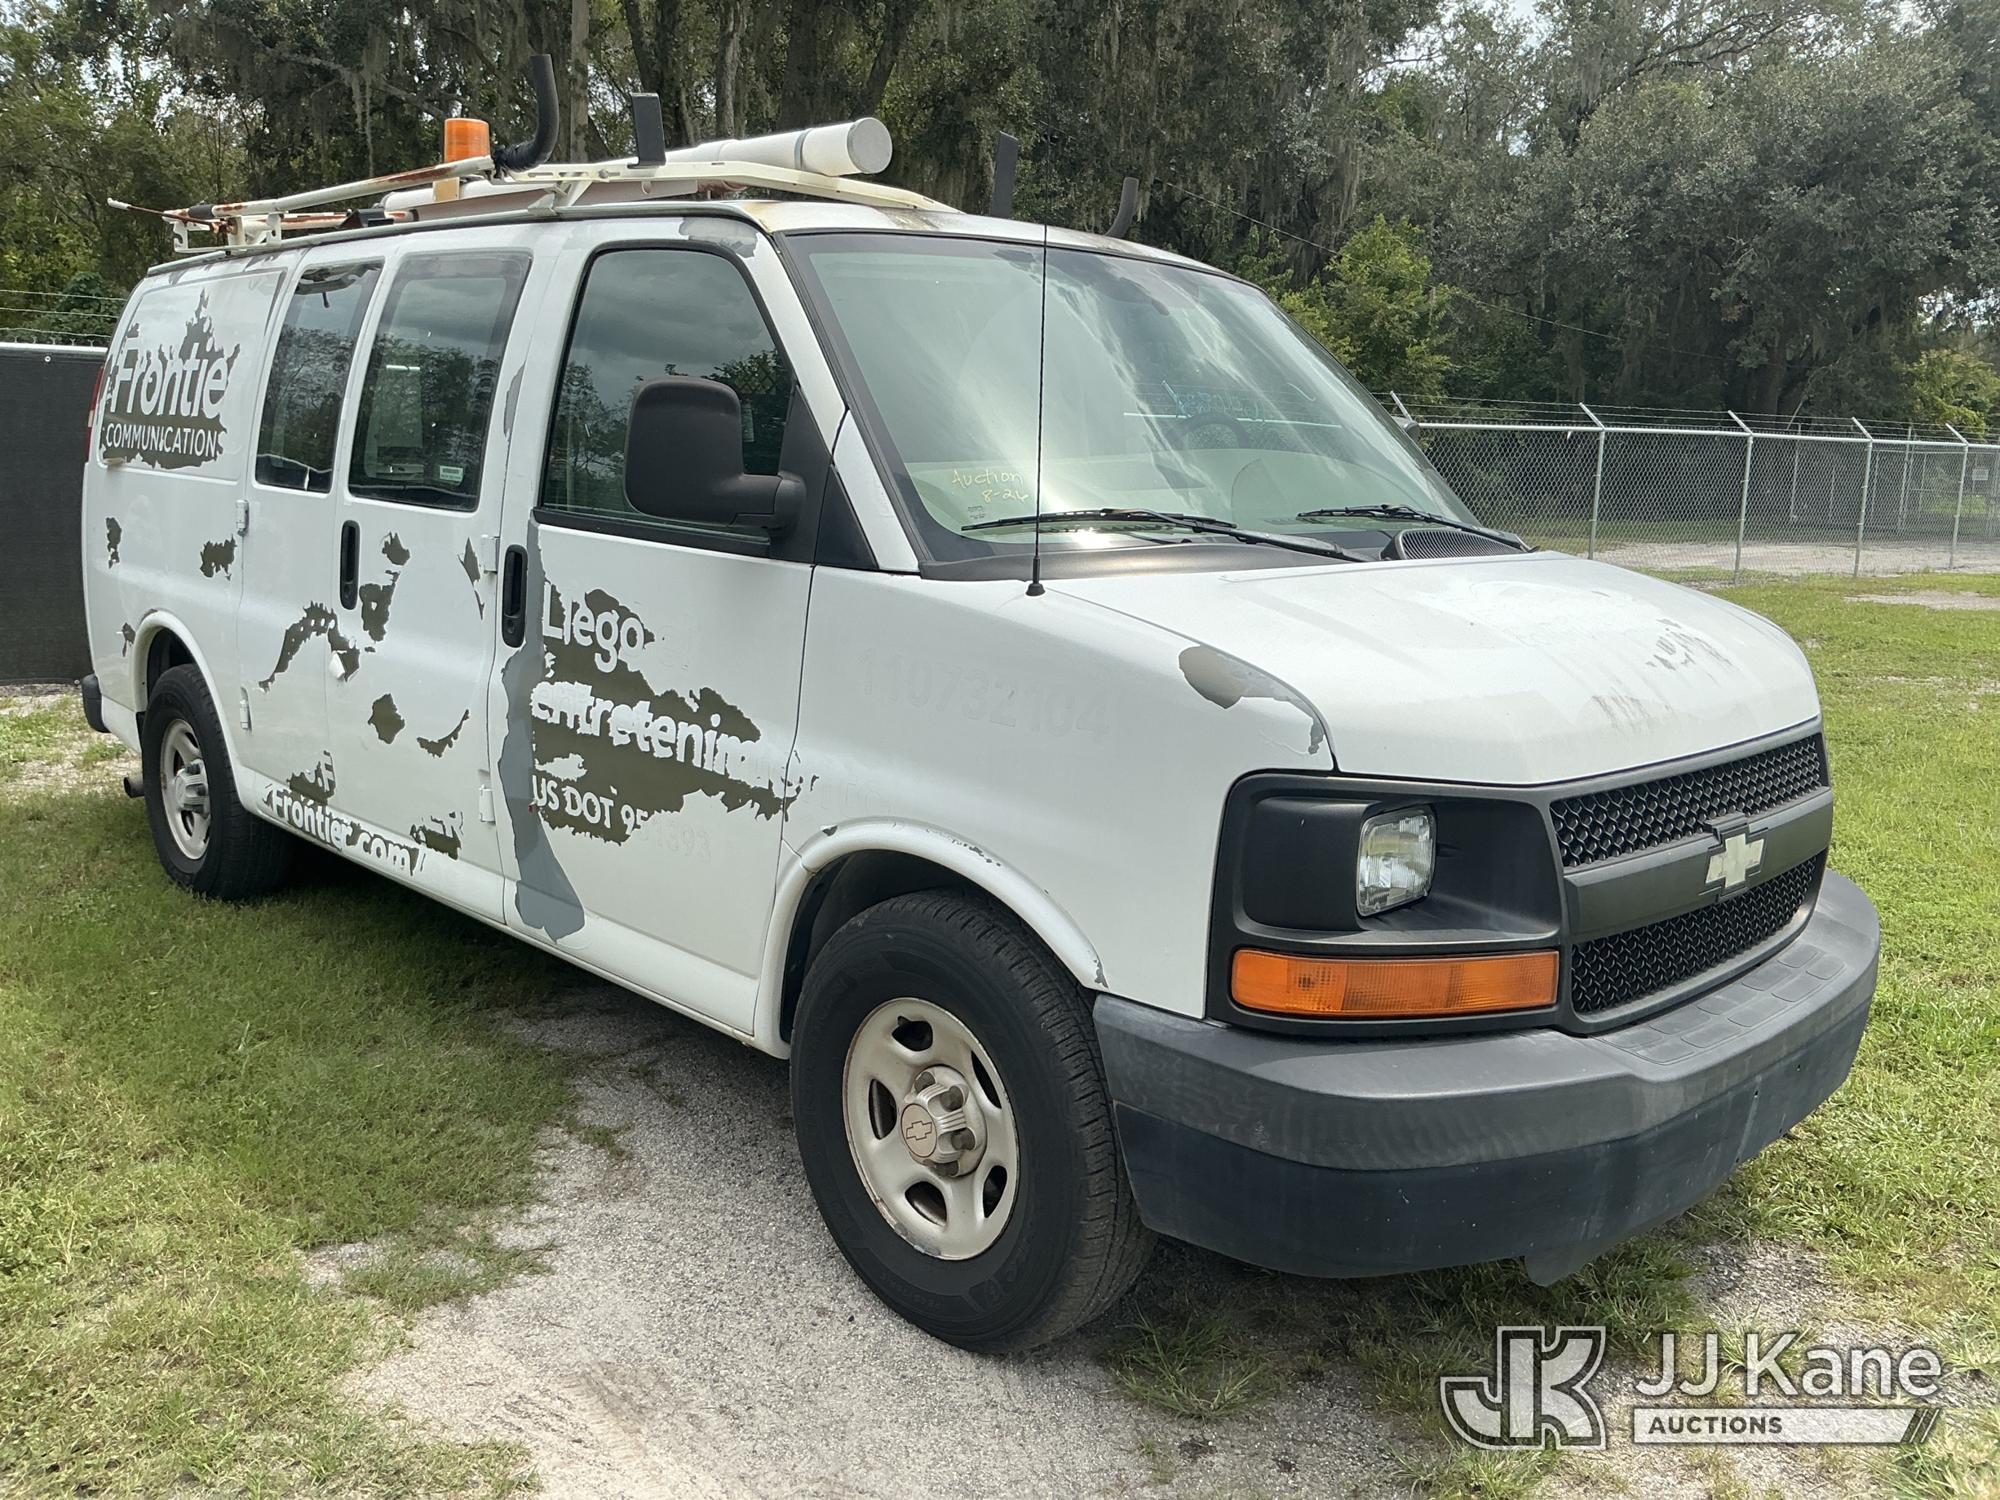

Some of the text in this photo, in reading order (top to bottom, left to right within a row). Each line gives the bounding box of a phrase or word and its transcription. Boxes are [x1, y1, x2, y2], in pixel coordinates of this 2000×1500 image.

[109, 337, 229, 419] Frontie
[951, 468, 1023, 489] Auction
[532, 774, 560, 811] US
[562, 785, 614, 829] DOT
